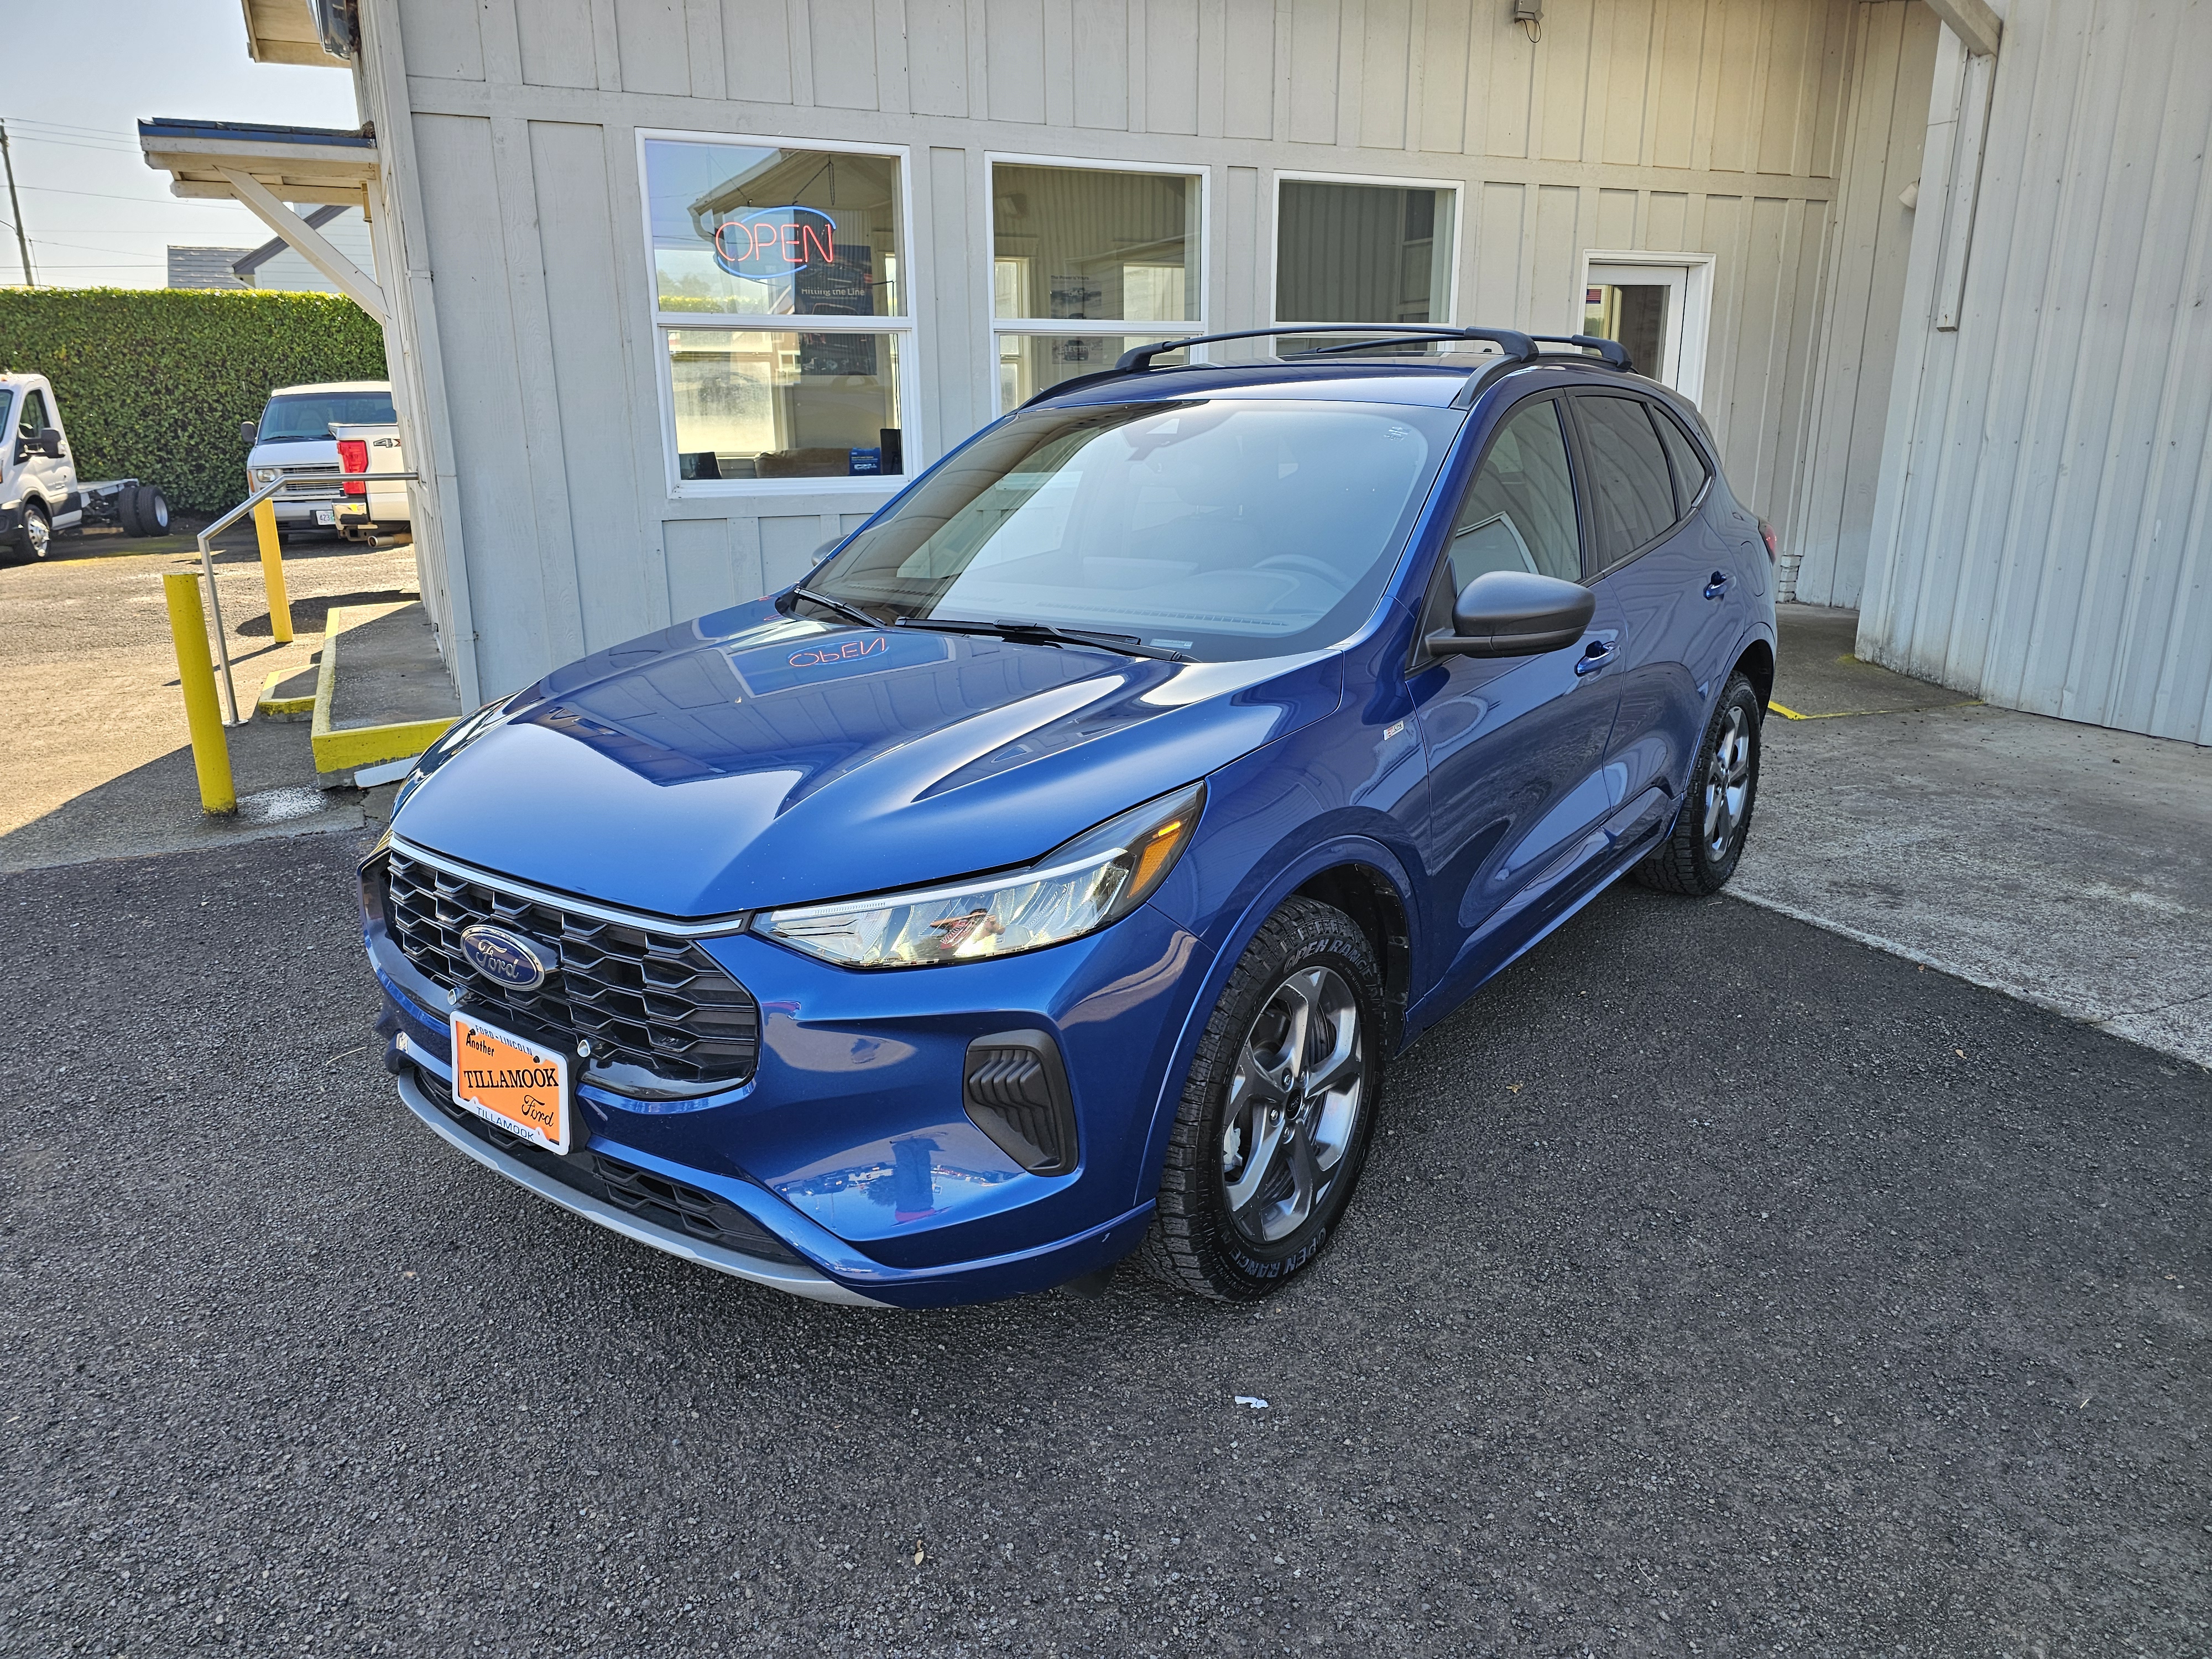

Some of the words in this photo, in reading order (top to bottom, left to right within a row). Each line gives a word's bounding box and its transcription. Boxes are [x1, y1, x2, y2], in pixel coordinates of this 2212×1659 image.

[716, 221, 834, 263] OPEN
[475, 939, 519, 979] Ford
[1283, 937, 1329, 974] OPEN
[1327, 937, 1373, 981] RANGE
[466, 1032, 494, 1057] Another
[463, 1068, 559, 1088] TILLAMOOK
[476, 1106, 535, 1141] TILLAMOOK
[521, 1094, 554, 1127] Ford
[1229, 1245, 1280, 1277] RANGE
[1282, 1227, 1327, 1275] OPEN
